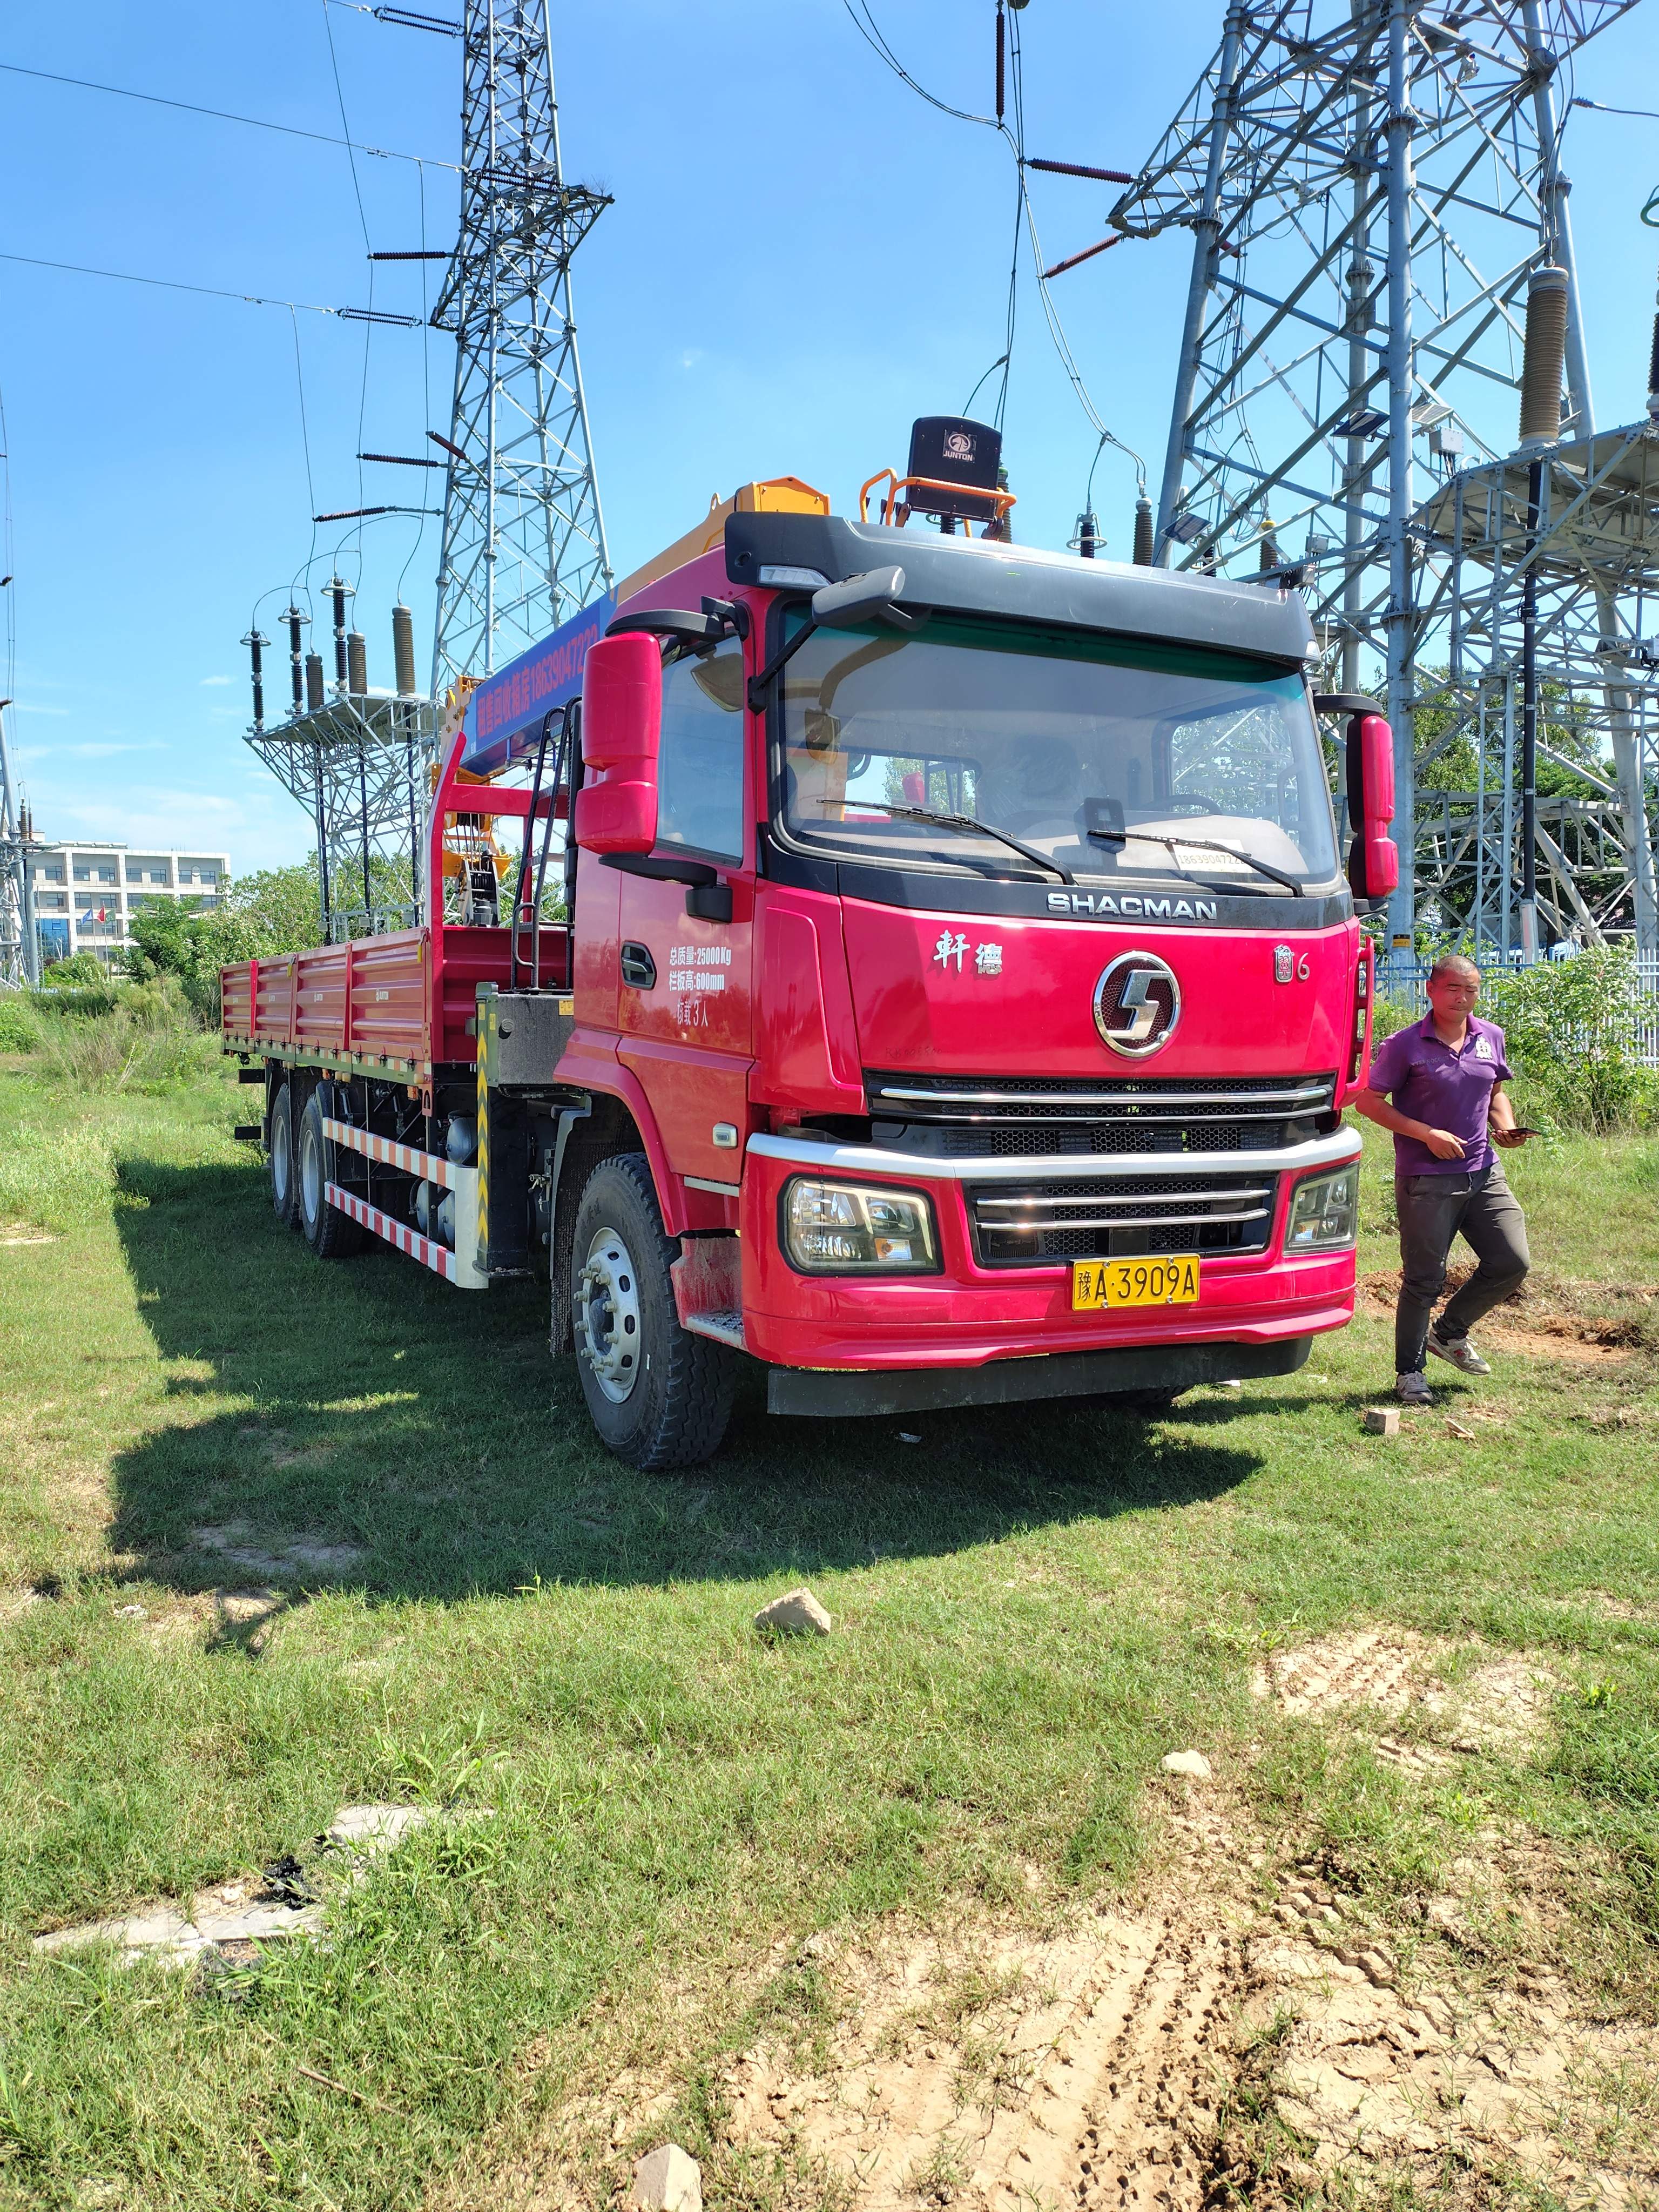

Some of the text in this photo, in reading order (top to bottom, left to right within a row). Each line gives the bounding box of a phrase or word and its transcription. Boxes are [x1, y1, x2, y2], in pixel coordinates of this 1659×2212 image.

[943, 450, 973, 461] JUNTON
[1047, 892, 1217, 920] SHACMAN
[669, 946, 731, 966] 总质量:25000Kg
[669, 970, 725, 992] 栏板高:600mm
[1077, 1264, 1195, 1301] 豫A·3909A
